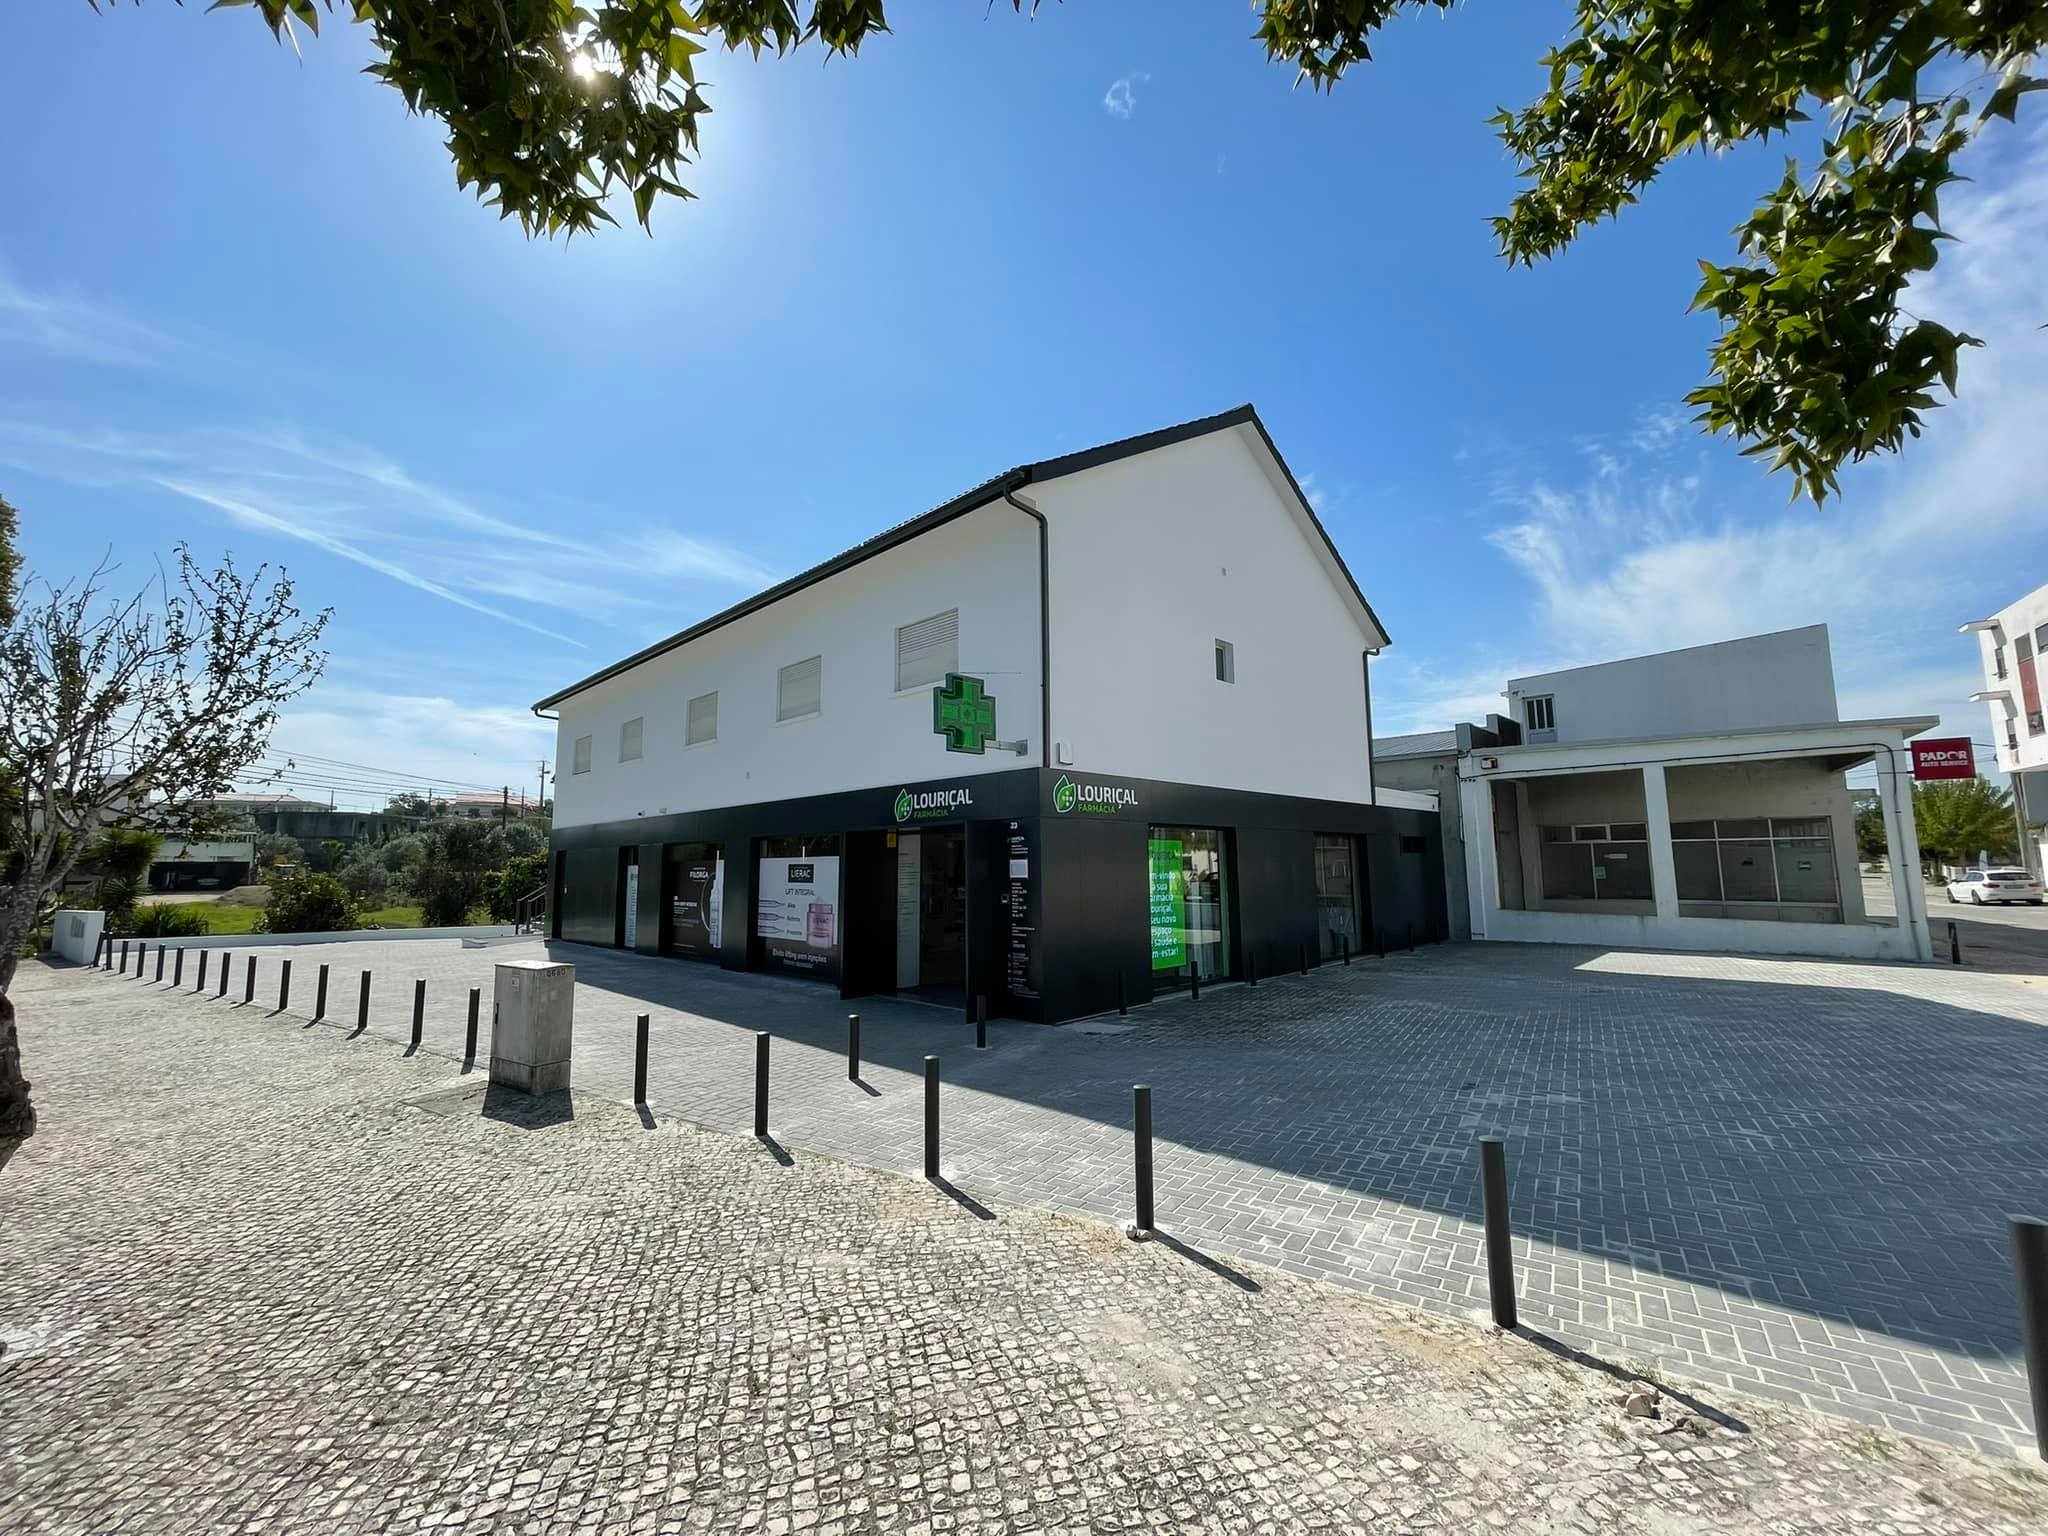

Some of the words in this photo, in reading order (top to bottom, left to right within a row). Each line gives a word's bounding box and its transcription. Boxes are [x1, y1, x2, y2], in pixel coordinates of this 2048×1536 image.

[913, 788, 974, 811] LOURIÇAL
[1077, 784, 1139, 809] LOURIÇAL
[913, 808, 949, 818] FARMÁCIA
[1078, 803, 1116, 814] FARMÁCIA
